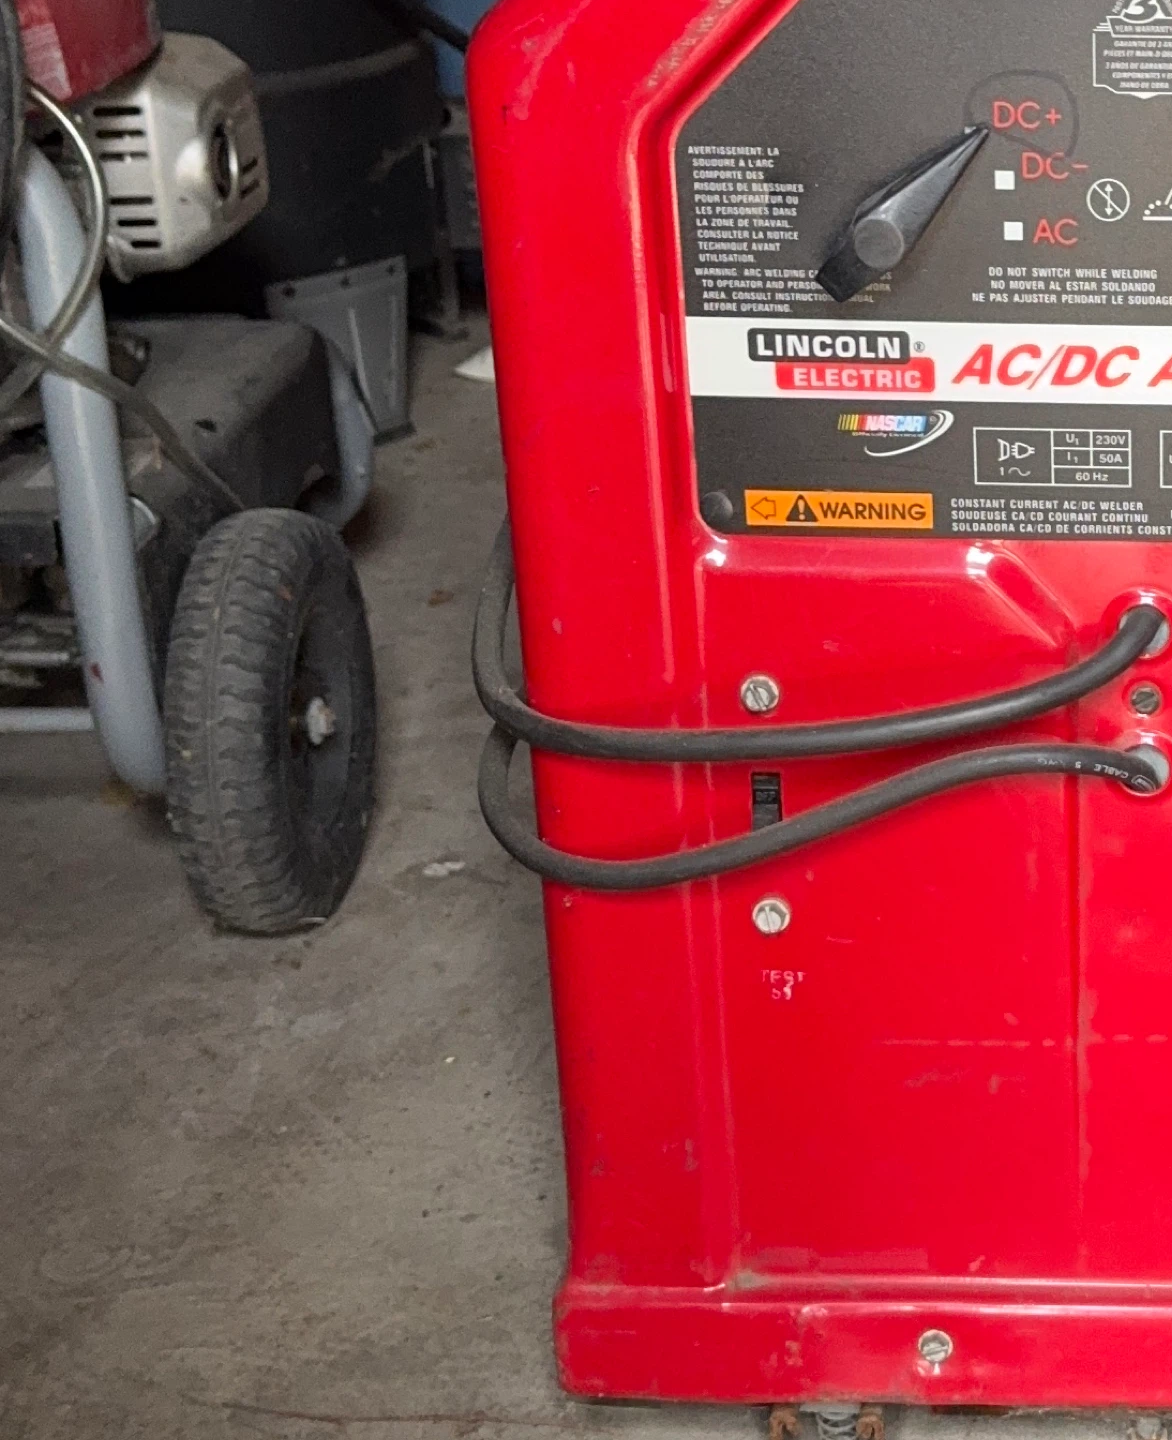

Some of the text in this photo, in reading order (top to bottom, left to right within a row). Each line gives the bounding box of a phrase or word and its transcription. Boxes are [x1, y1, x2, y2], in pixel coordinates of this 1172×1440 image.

[992, 101, 1062, 129] DC+
[1033, 218, 1079, 246] AC
[743, 267, 762, 278] ARC
[764, 268, 806, 279] WELDING
[988, 267, 1158, 280] DO NOT SWITCH WHILE WELDING
[701, 279, 714, 288] TO
[716, 279, 764, 289] OPERATOR
[990, 280, 1156, 292] NO MOVER AL ESTAR SOLDANDO
[972, 292, 985, 302] NE
[989, 292, 1009, 303] PAS
[1013, 293, 1057, 304] AJUSTER
[1061, 294, 1109, 305] PENDANT
[1111, 294, 1124, 305] LE
[755, 333, 901, 359] LINCOLN
[951, 343, 1140, 390] AC/DC
[793, 367, 922, 389] ELECTRIC
[865, 414, 927, 432] NASCAR
[1095, 435, 1126, 446] 230V
[1098, 453, 1123, 464] 50A
[1075, 472, 1109, 482] 60 Hz
[950, 497, 1144, 511] CONSTANT CURRENT AC/DC WELDER
[819, 501, 927, 522] WARNING
[950, 510, 1008, 521] SOUDEUSE
[1048, 511, 1098, 522] COURANT
[1101, 512, 1149, 523] CONTINU
[951, 522, 1015, 533] SOLDADORA
[1018, 523, 1051, 534] CA/CD
[1055, 523, 1070, 534] DE
[1093, 763, 1130, 779] CABLE
